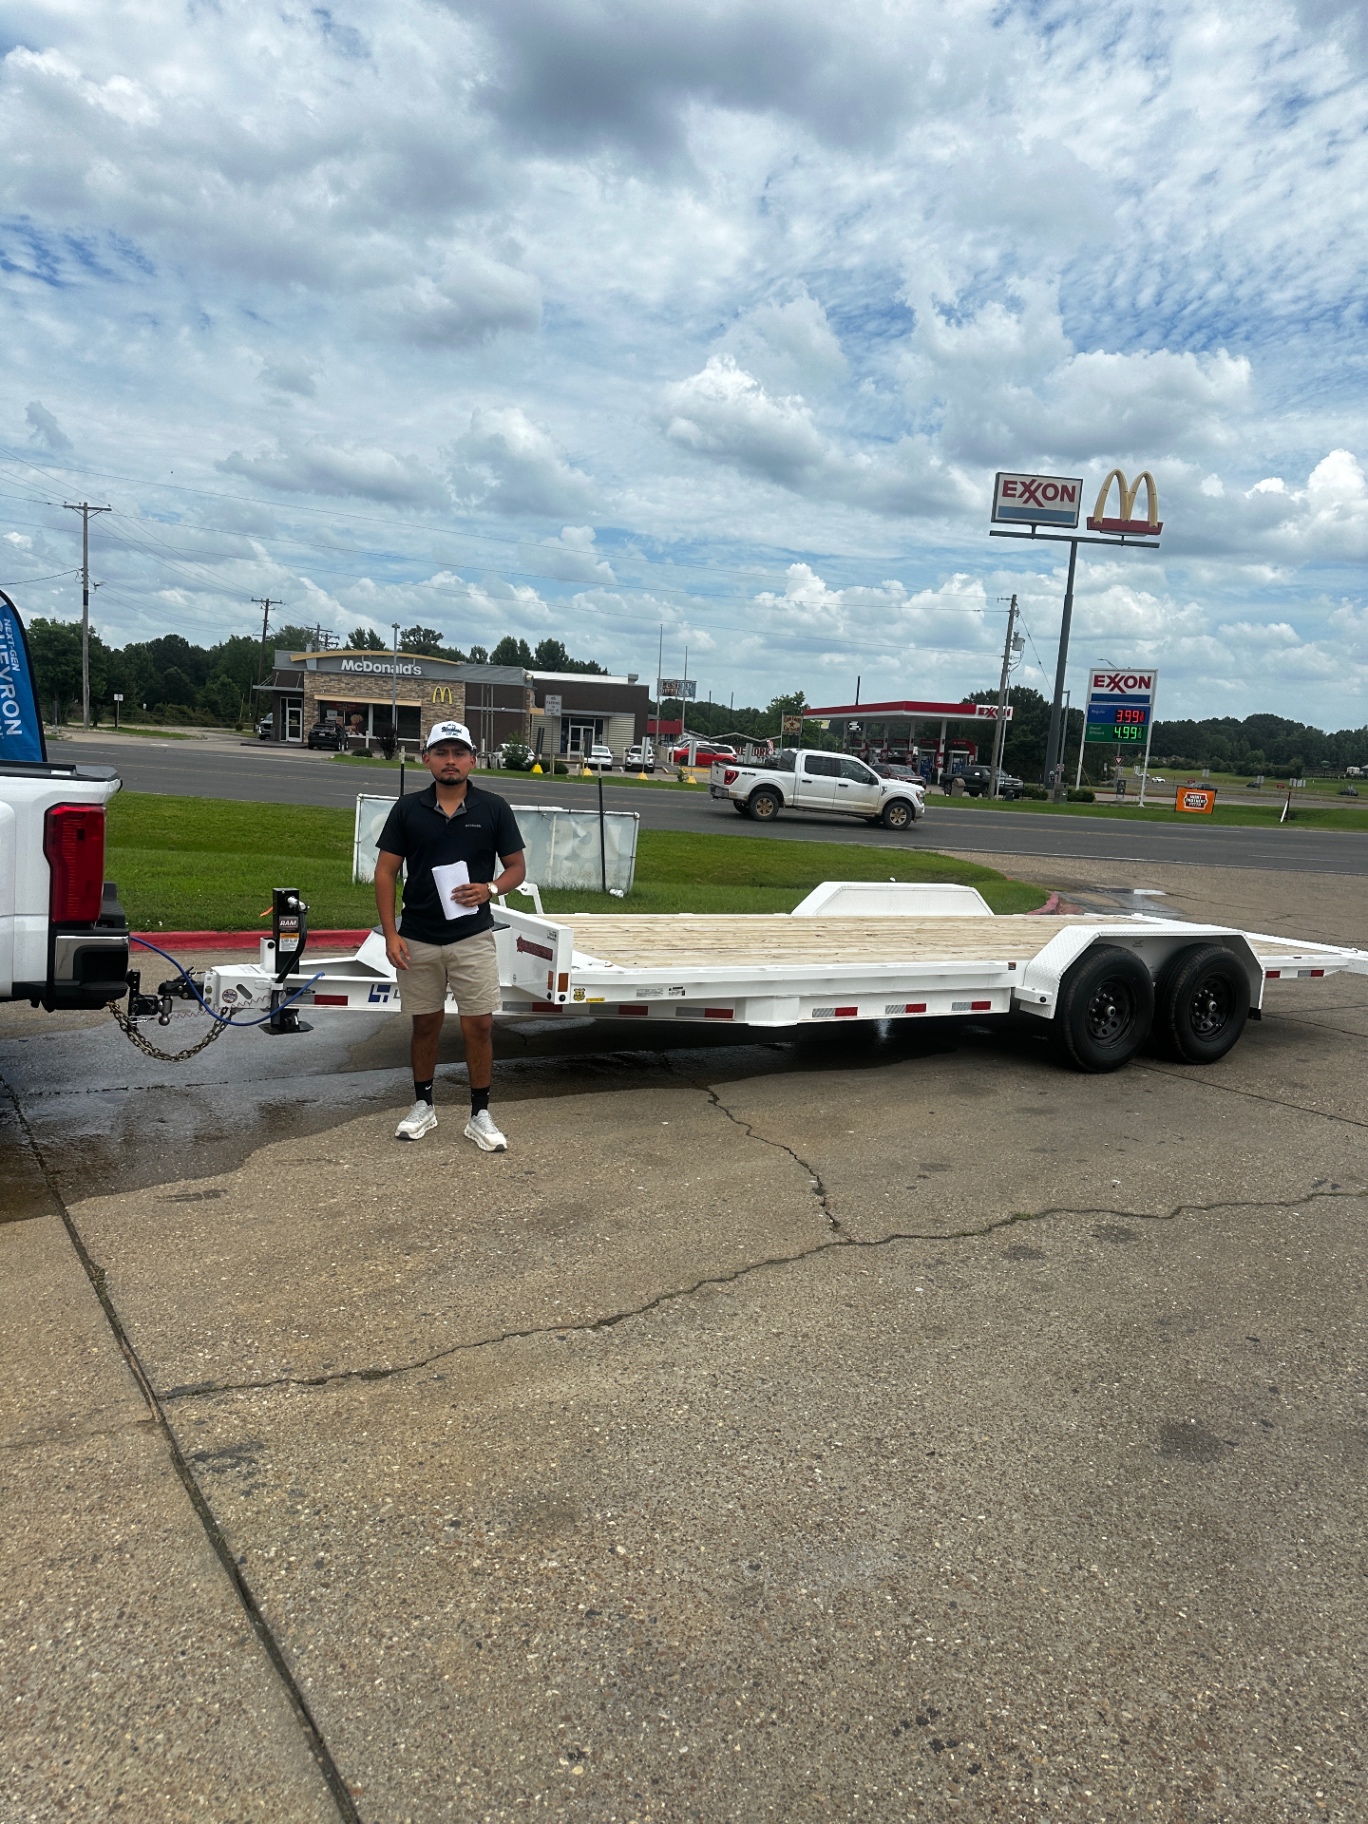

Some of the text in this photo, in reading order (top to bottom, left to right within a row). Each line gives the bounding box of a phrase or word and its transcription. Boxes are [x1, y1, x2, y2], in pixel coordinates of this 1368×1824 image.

[1002, 479, 1076, 508] EXXON
[4, 618, 20, 671] NEXT-GEN
[340, 659, 422, 676] McDonald's
[1093, 673, 1152, 693] EXXON
